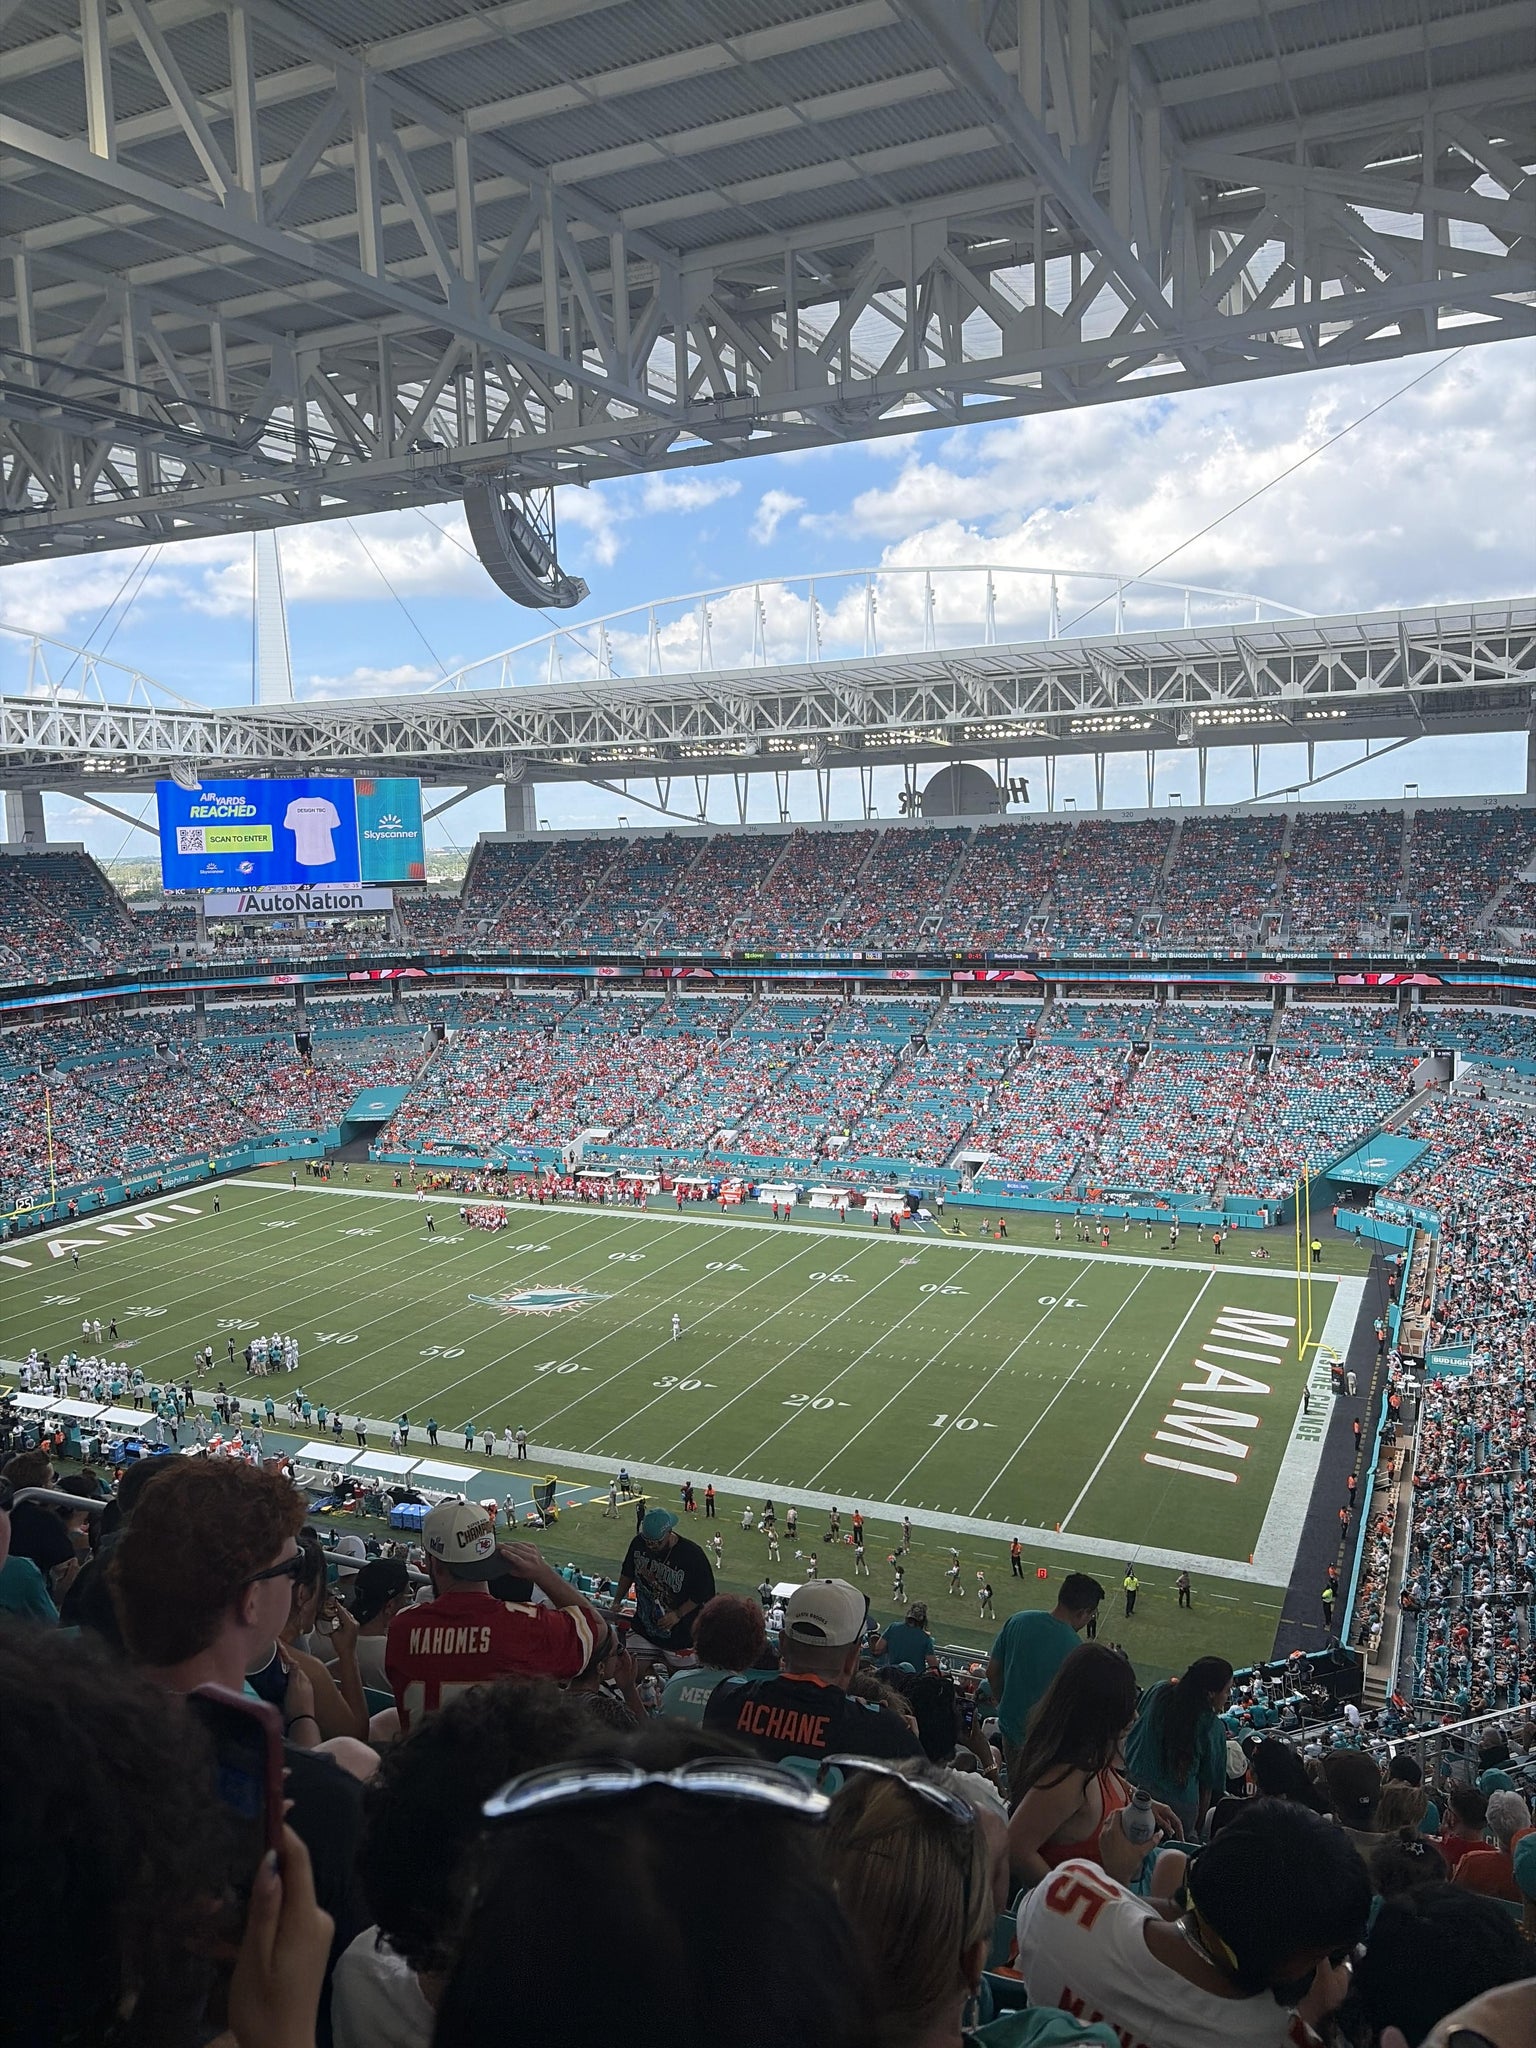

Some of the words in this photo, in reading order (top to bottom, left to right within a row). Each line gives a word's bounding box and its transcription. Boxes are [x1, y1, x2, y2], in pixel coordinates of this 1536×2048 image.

[200, 792, 217, 802] AIR
[215, 796, 246, 805] YARDS
[1483, 798, 1497, 806] 323
[190, 804, 257, 818] REACHED
[210, 835, 228, 843] SCAN
[230, 834, 243, 842] TO
[244, 833, 268, 842] ENTER
[364, 829, 418, 841] Skyscanner
[244, 892, 363, 913] AutoNation
[162, 1174, 189, 1188] olphins
[1355, 1170, 1388, 1179] MSC
[18, 1200, 31, 1209] 25
[607, 1252, 647, 1262] 50
[705, 1261, 745, 1272] 40
[808, 1271, 850, 1283] 30
[919, 1283, 963, 1295] 20
[40, 1294, 81, 1306] 10
[1038, 1296, 1080, 1308] 10
[124, 1306, 168, 1318] 20
[217, 1318, 260, 1331] 30
[315, 1331, 359, 1345] 40
[419, 1345, 465, 1359] 50
[533, 1360, 579, 1374] 40
[653, 1375, 702, 1391] 30
[1143, 1305, 1297, 1483] MIAMI
[781, 1393, 835, 1410] 20
[928, 1413, 980, 1431] 10
[1295, 1393, 1332, 1442] CHANGE
[1039, 1569, 1046, 1578] G
[409, 1626, 492, 1655] MAHOMES
[736, 1699, 832, 1748] ACHANE
